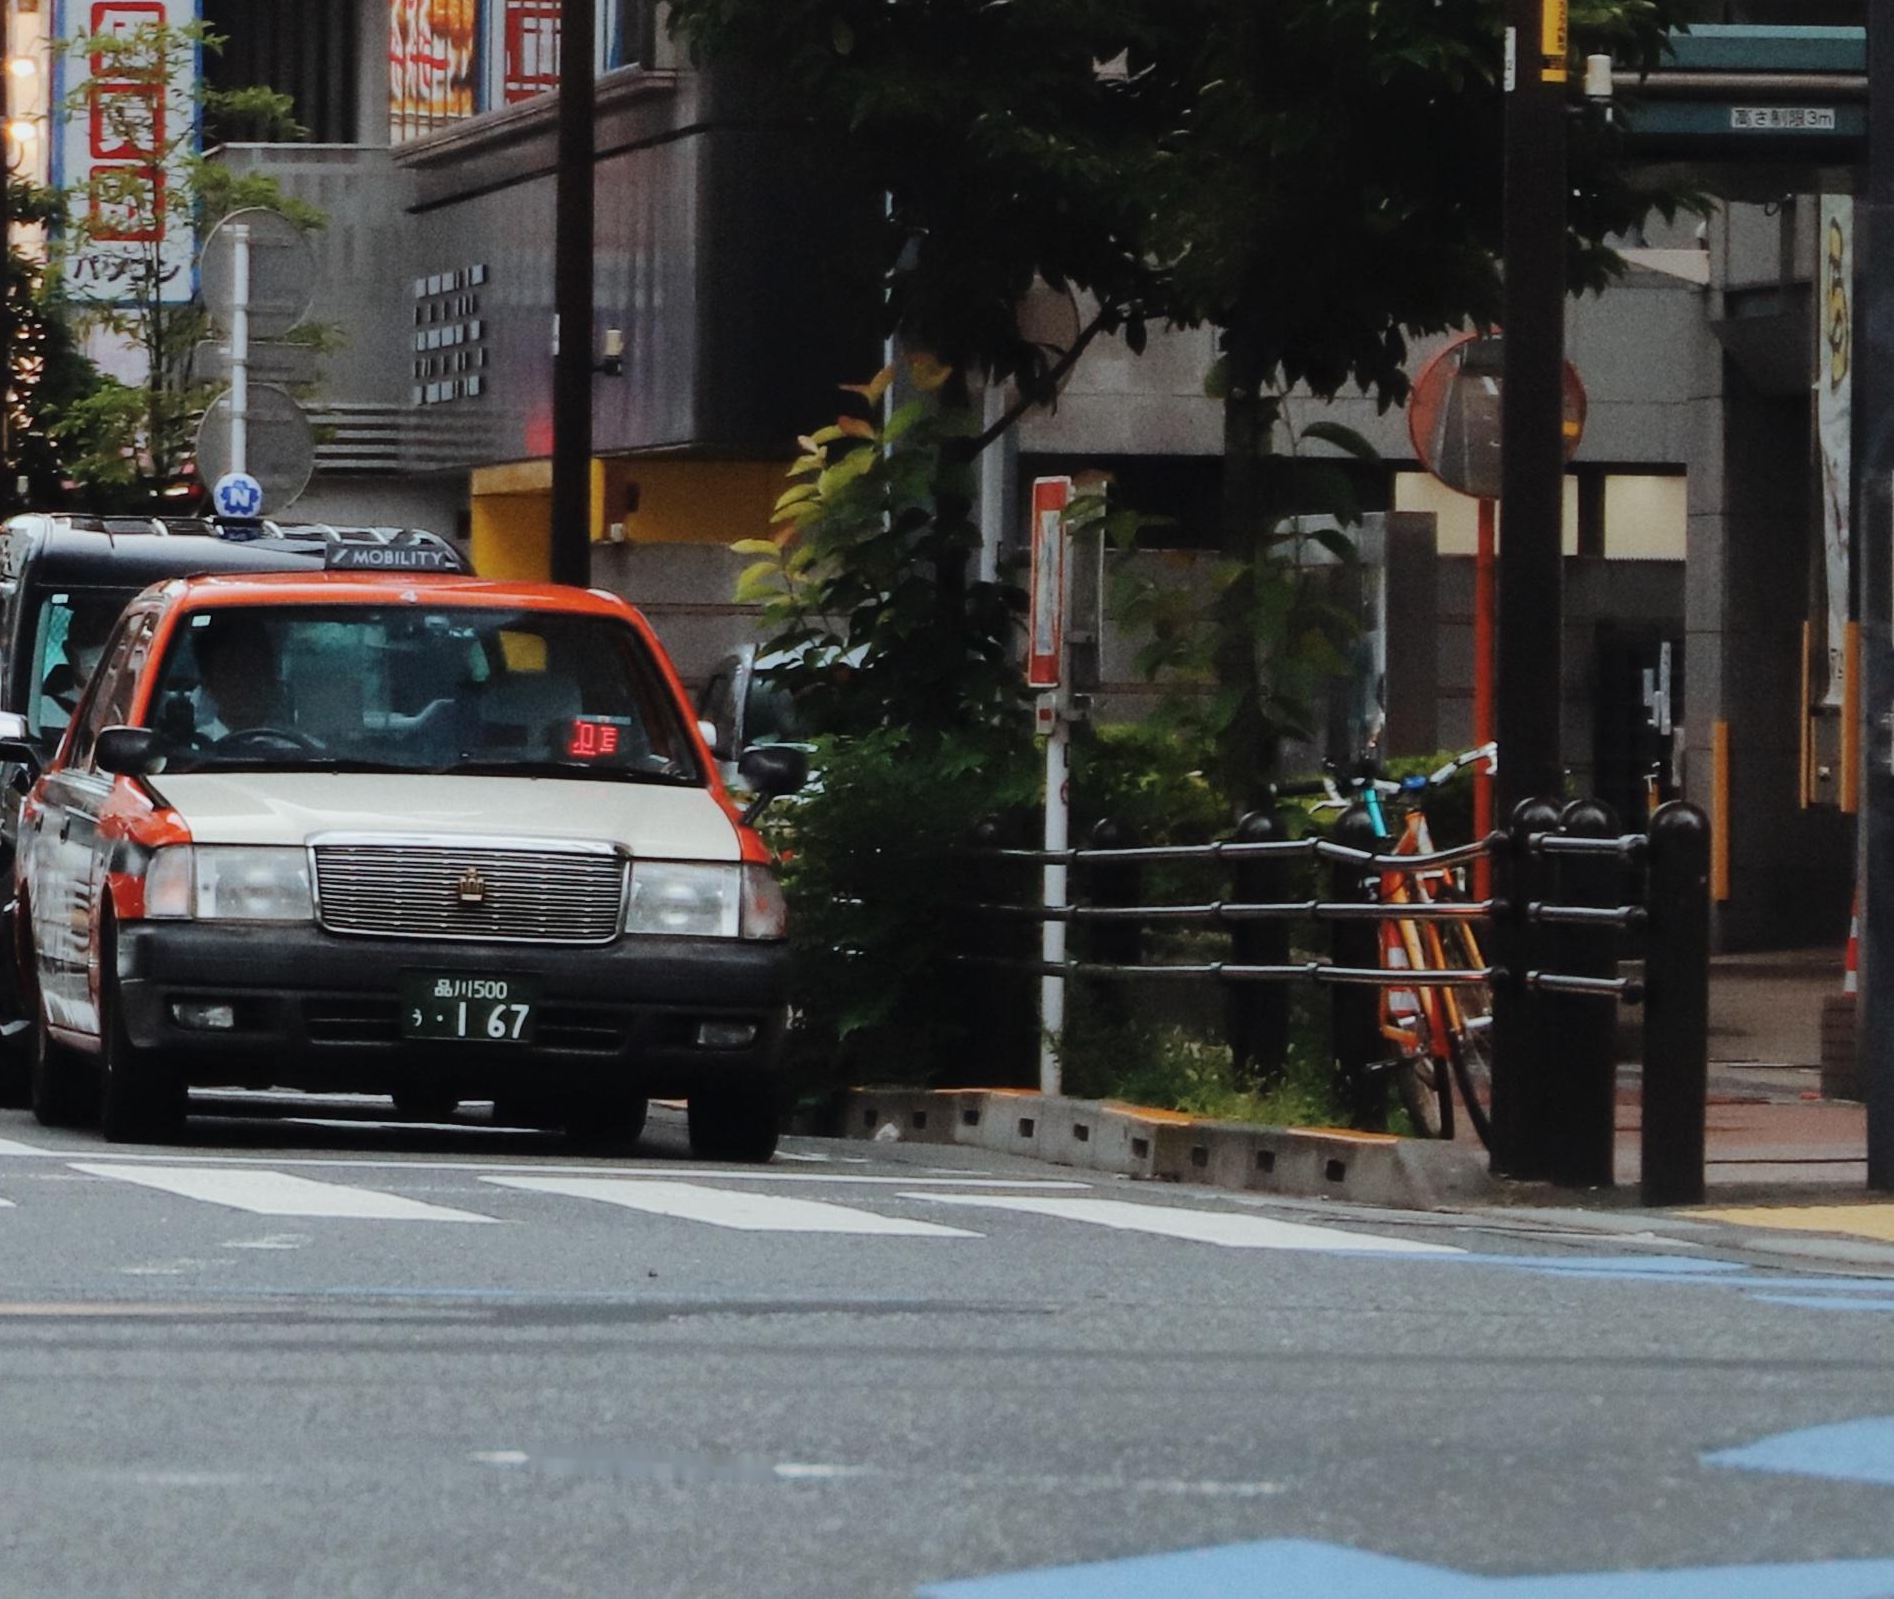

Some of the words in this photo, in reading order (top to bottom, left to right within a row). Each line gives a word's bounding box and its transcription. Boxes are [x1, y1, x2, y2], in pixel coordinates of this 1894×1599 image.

[1733, 109, 1834, 129] 高さ制限3m
[352, 550, 446, 565] MOBILITY
[434, 978, 508, 1000] 品川500
